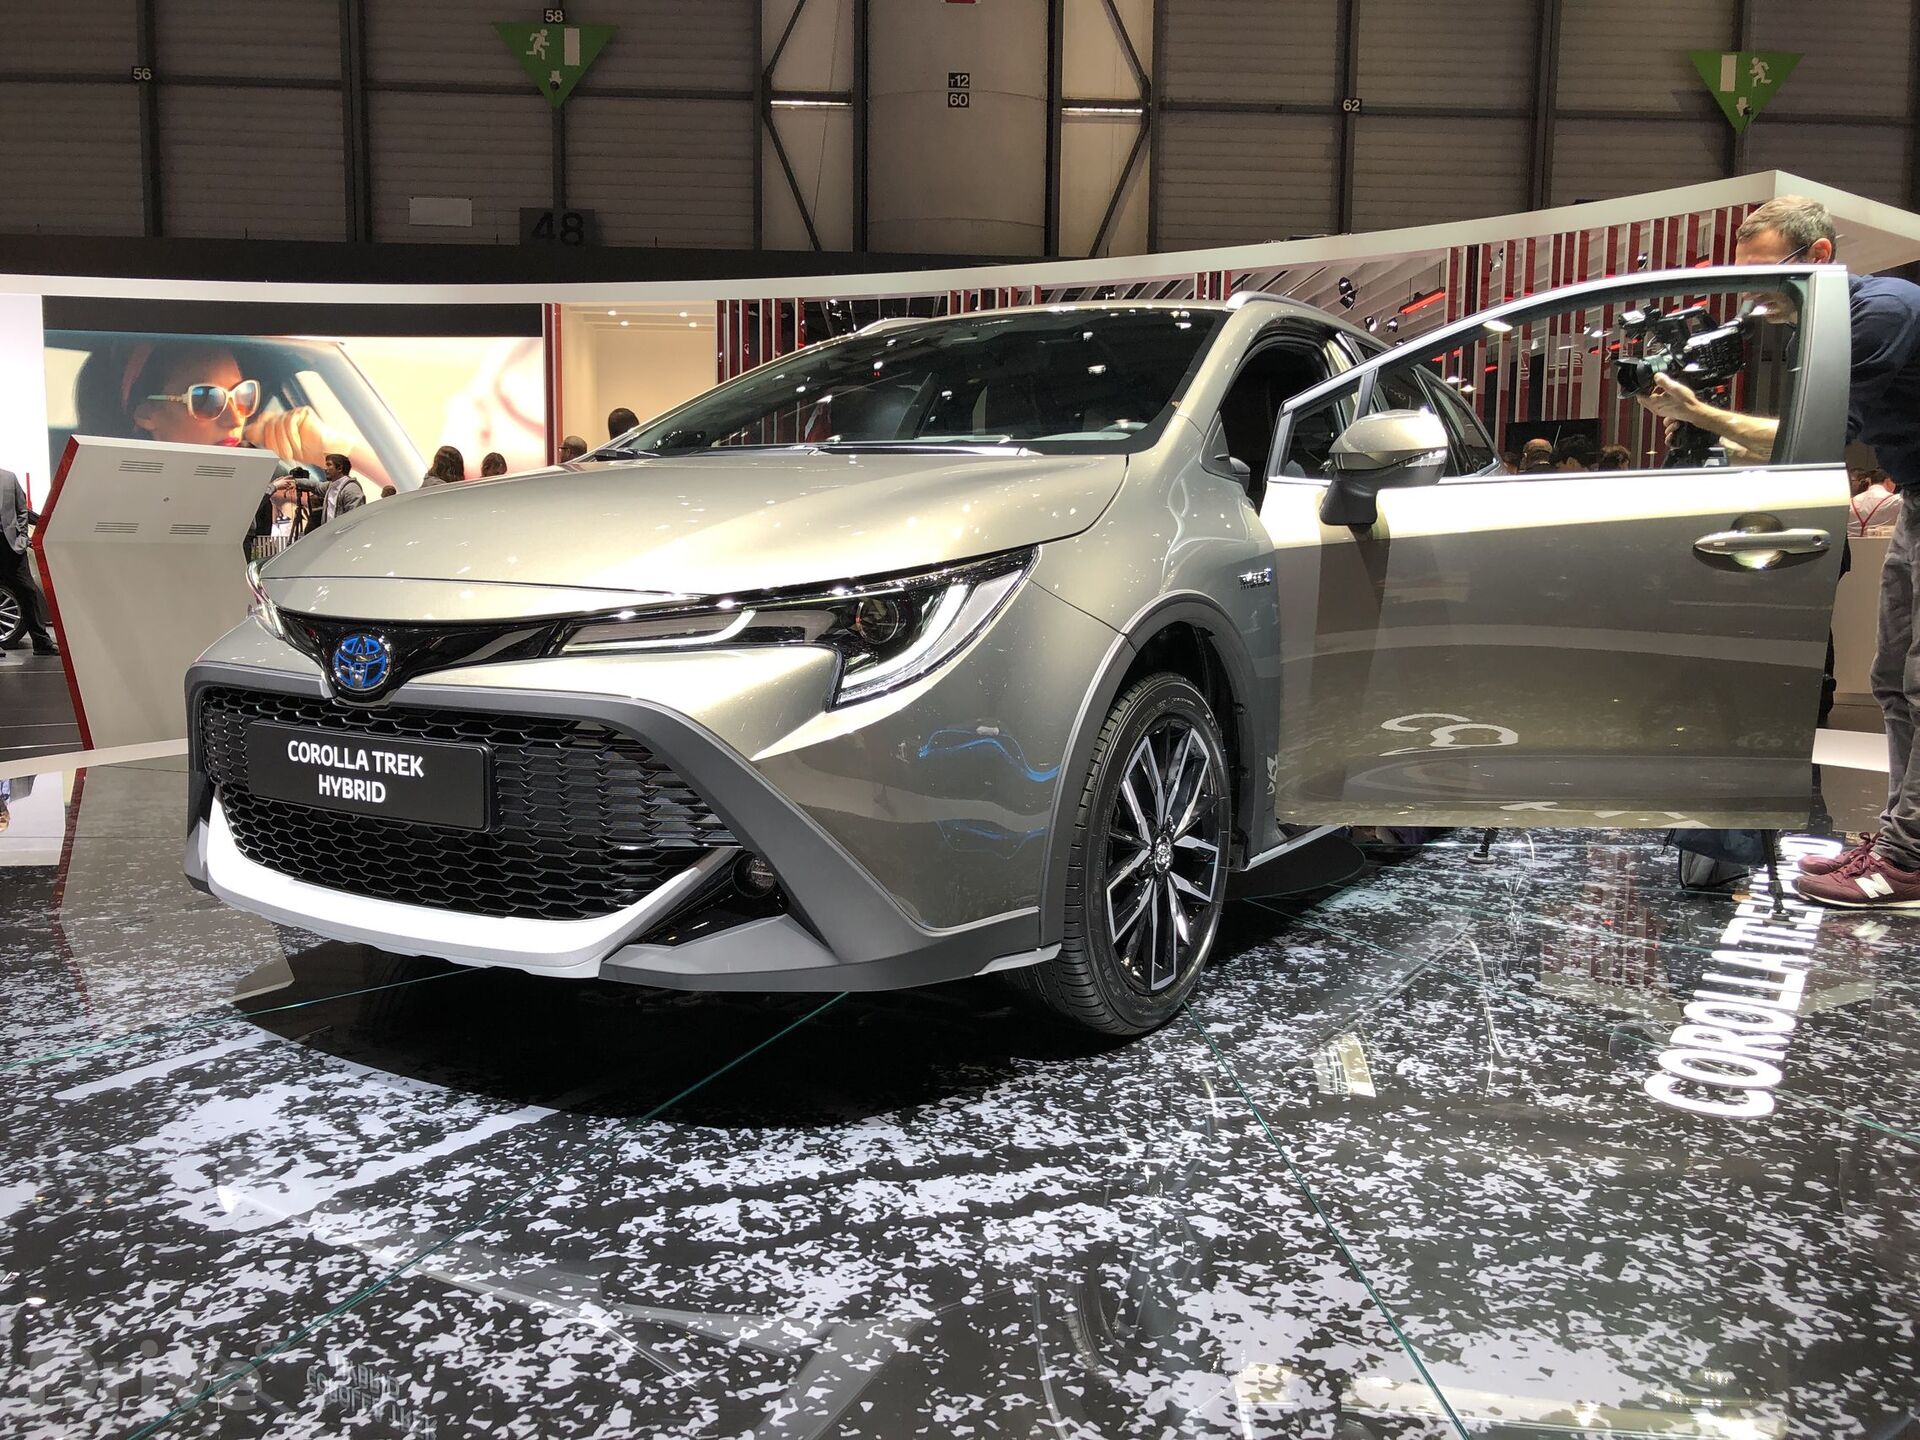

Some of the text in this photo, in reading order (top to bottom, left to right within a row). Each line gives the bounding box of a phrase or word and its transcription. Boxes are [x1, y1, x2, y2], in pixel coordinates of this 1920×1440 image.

[545, 9, 564, 23] 58
[133, 67, 152, 80] 56
[950, 93, 968, 106] 60
[1343, 99, 1360, 112] 62
[532, 211, 585, 247] 48
[287, 739, 424, 777] COROLLA TREK
[318, 773, 386, 804] HYBRID
[1644, 949, 1810, 1118] COROLLA
